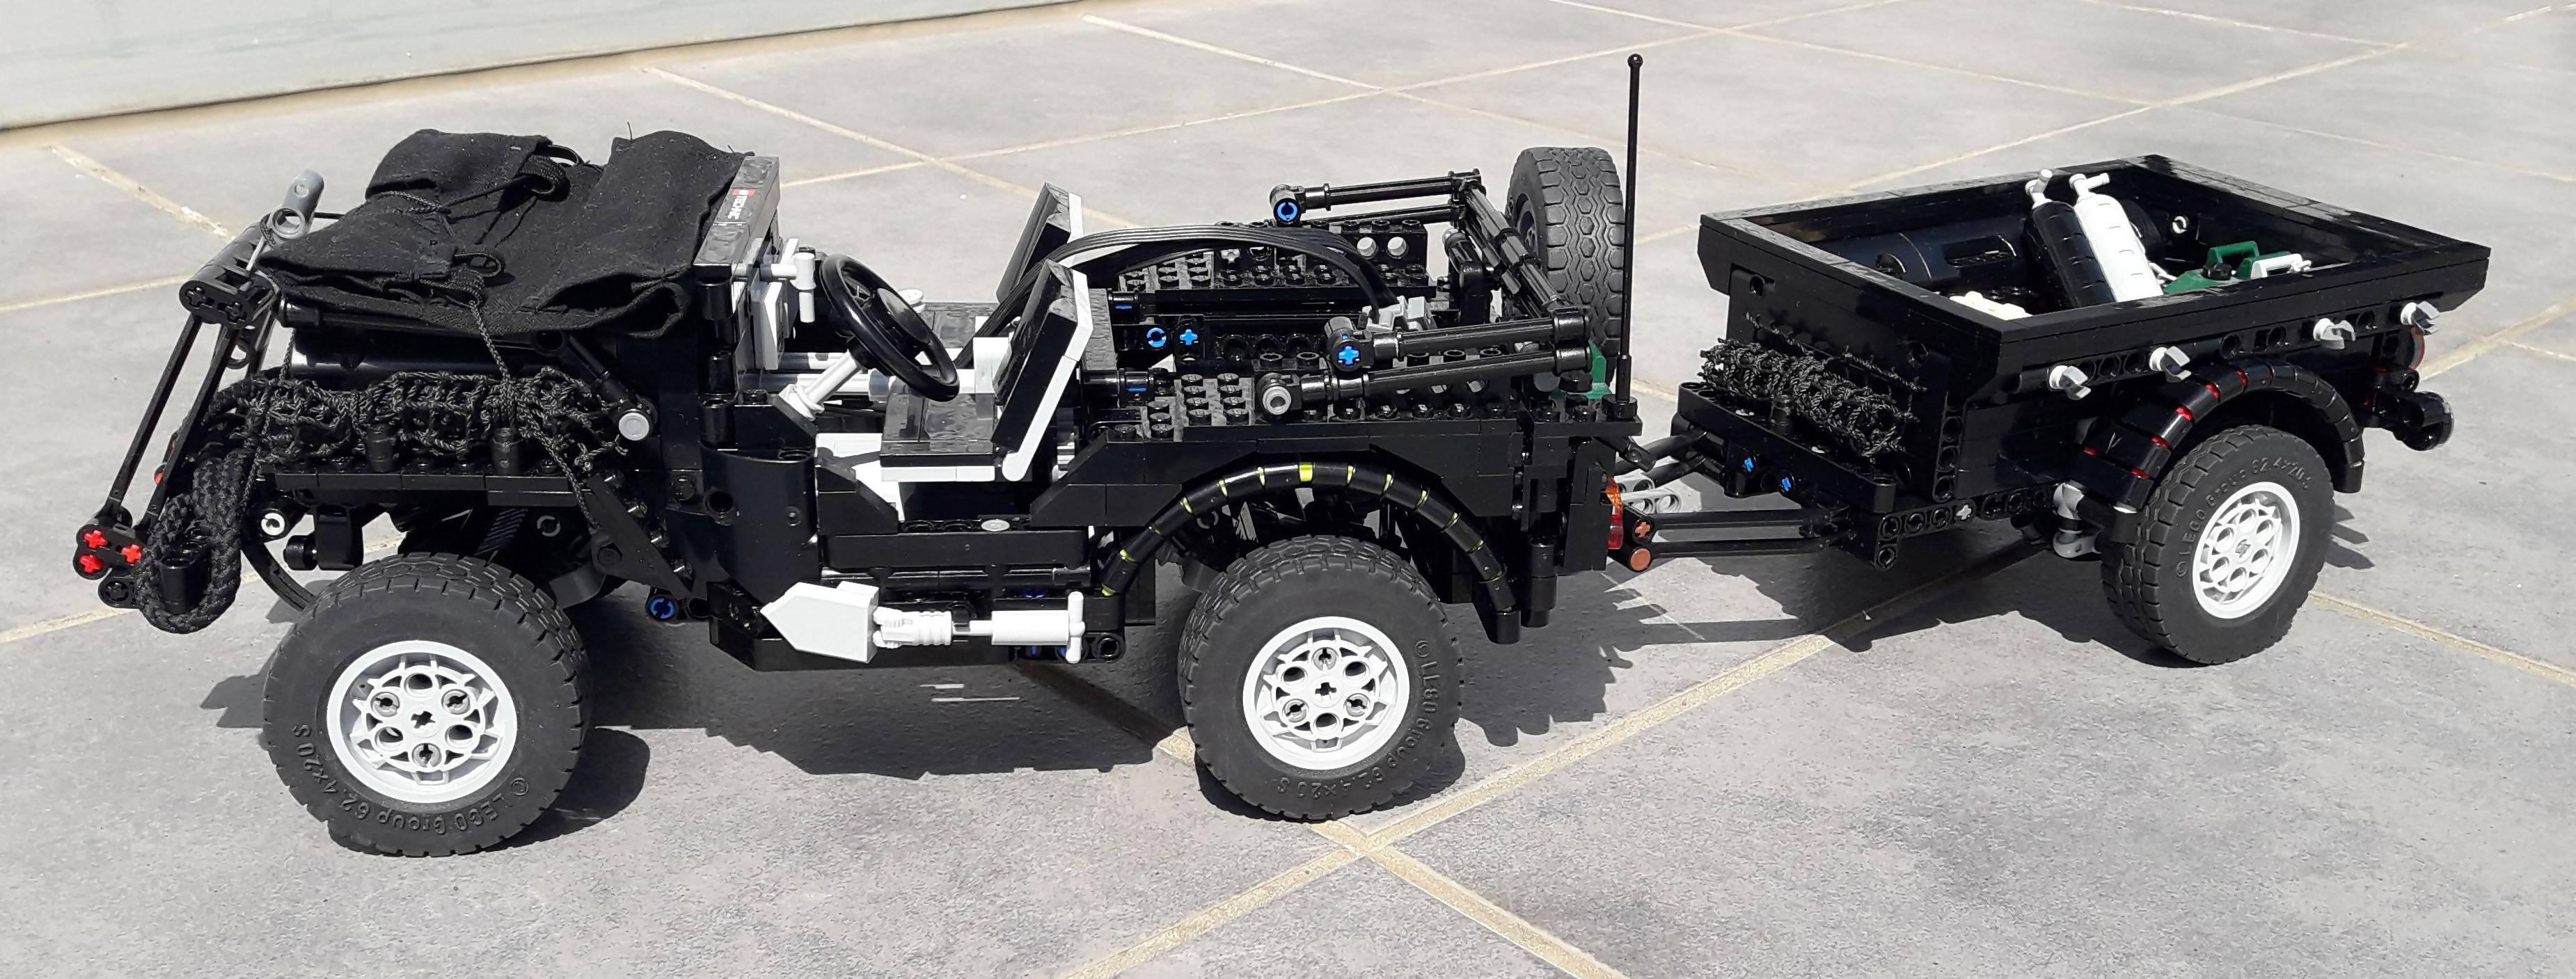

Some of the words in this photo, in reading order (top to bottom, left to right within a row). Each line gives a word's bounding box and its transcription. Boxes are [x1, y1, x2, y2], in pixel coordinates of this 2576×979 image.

[2179, 509, 2205, 556] LEGO
[377, 808, 447, 835] Group
[454, 793, 512, 832] LEGO
